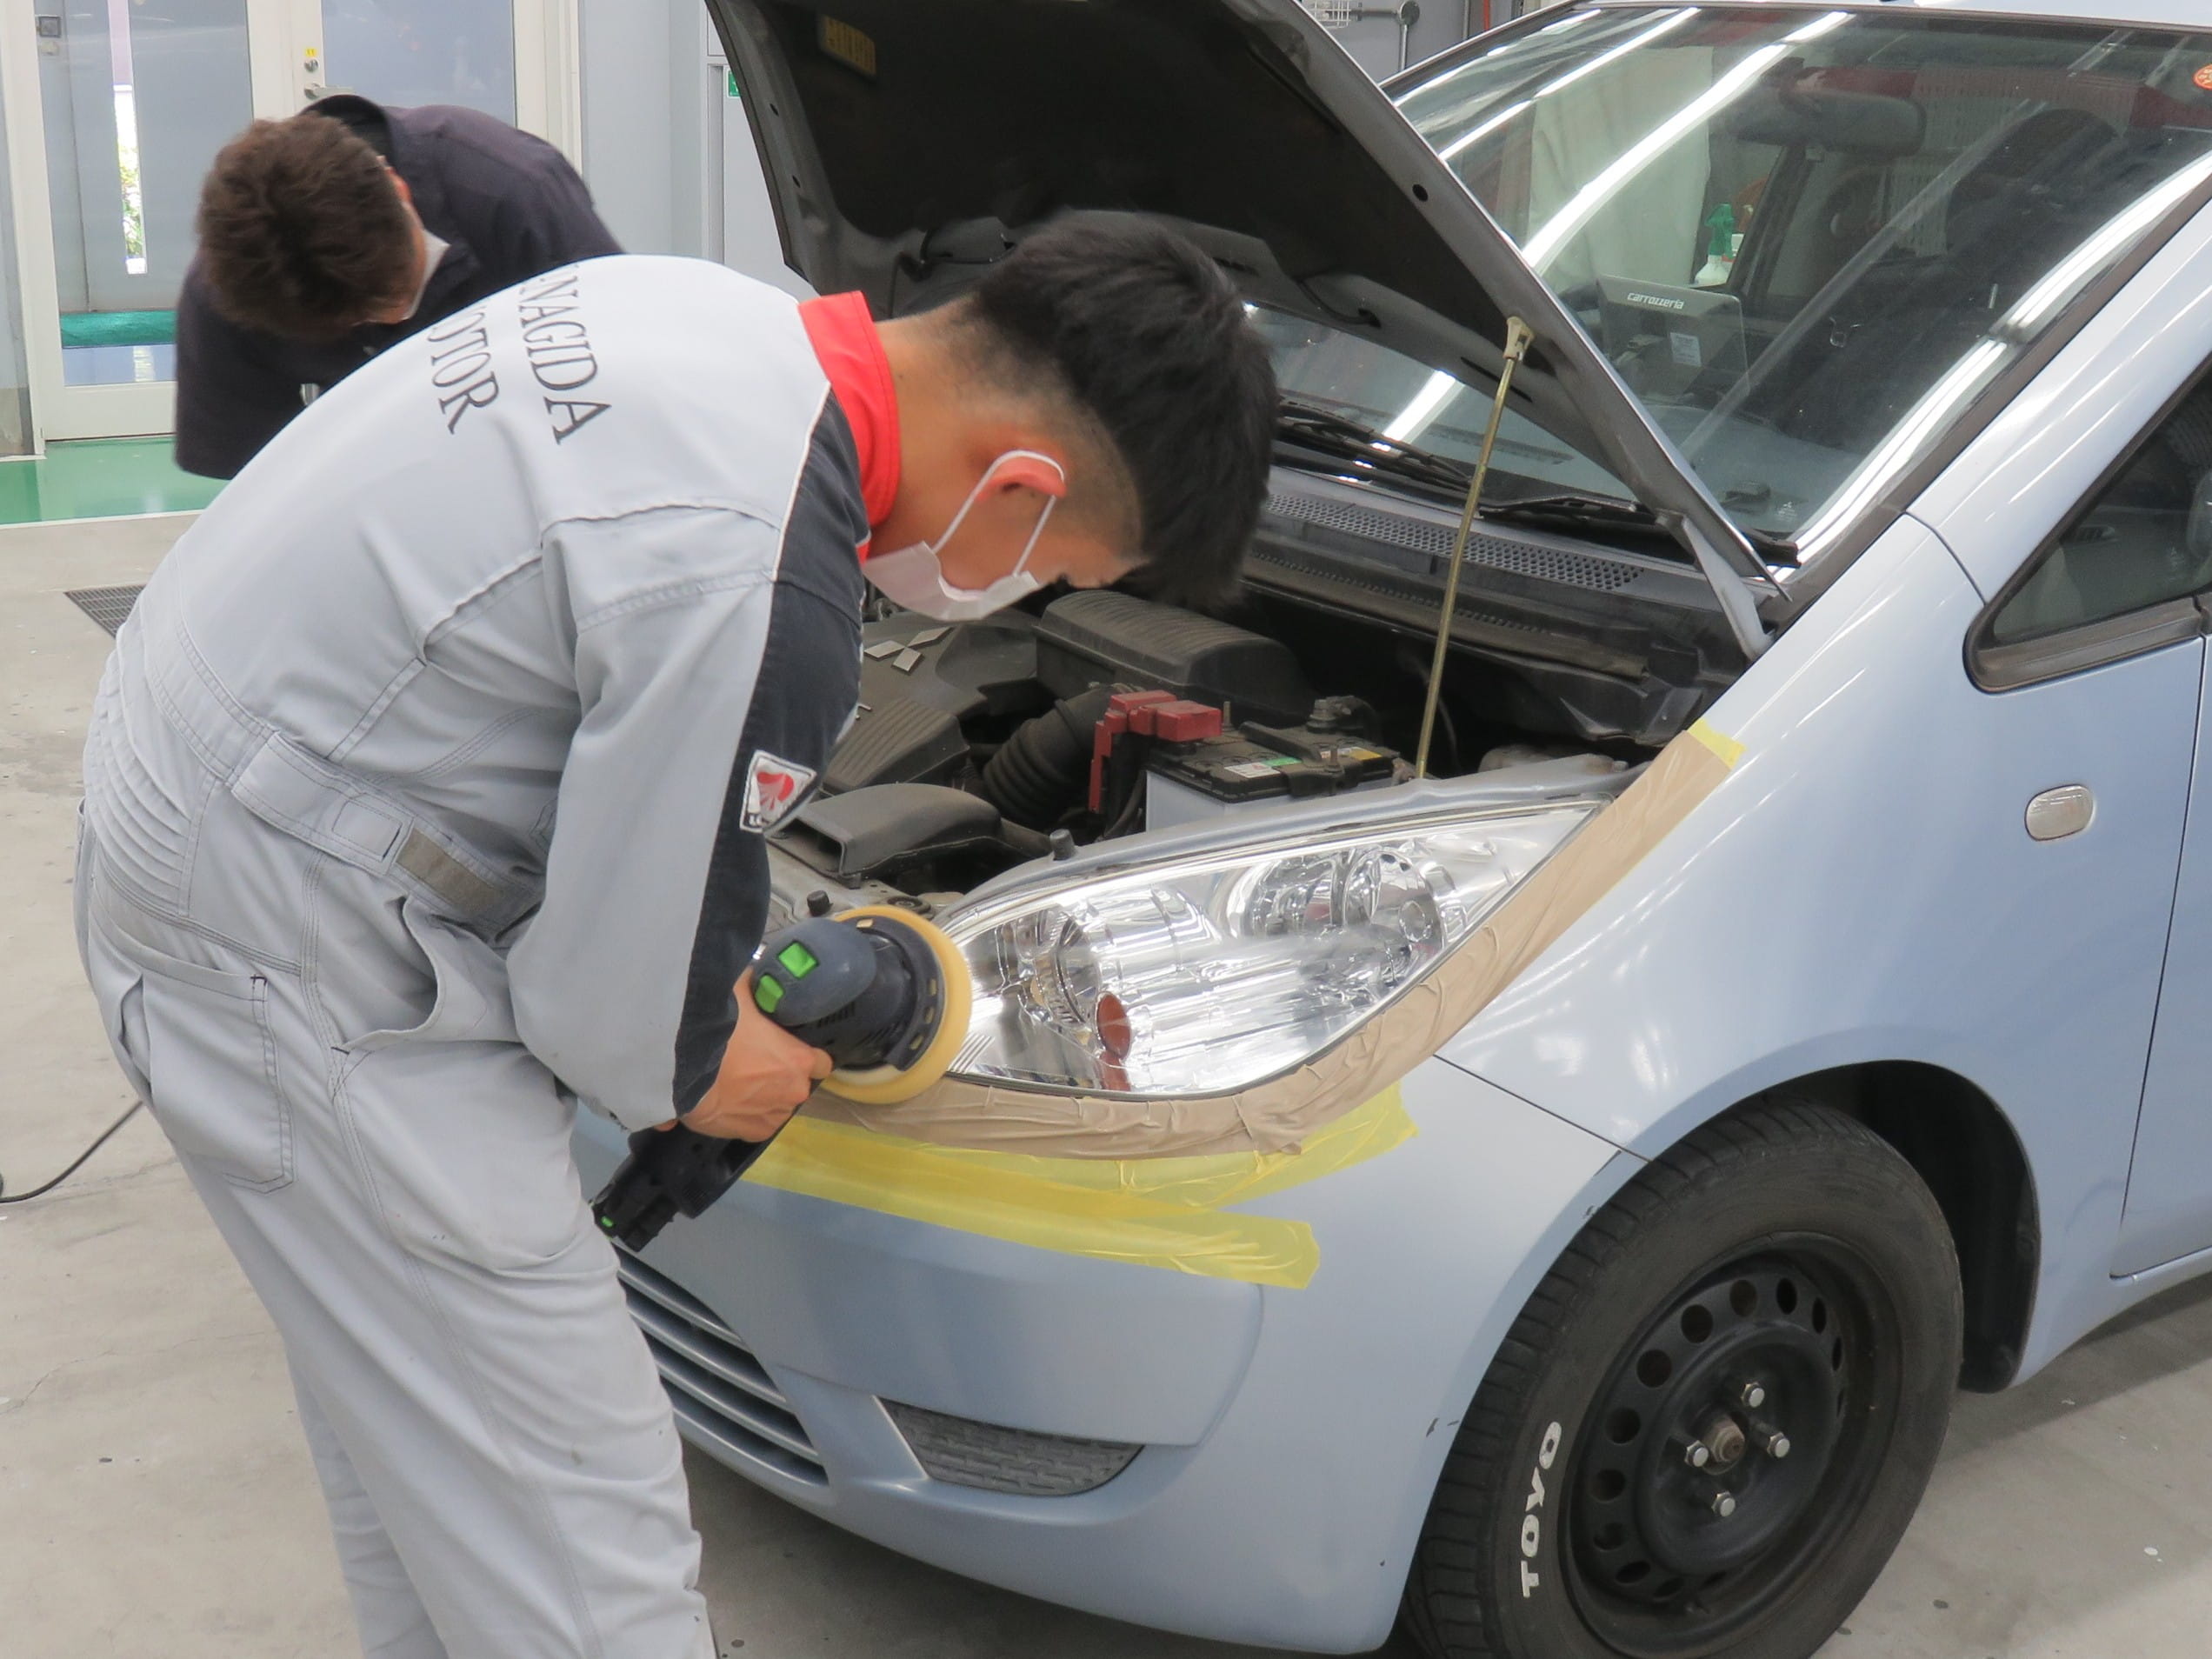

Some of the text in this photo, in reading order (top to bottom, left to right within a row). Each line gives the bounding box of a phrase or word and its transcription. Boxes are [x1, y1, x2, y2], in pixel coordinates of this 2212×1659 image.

[1627, 292, 1684, 310] carrozzeria
[427, 306, 499, 435] OTOR
[1521, 1421, 1562, 1598] TOYO
